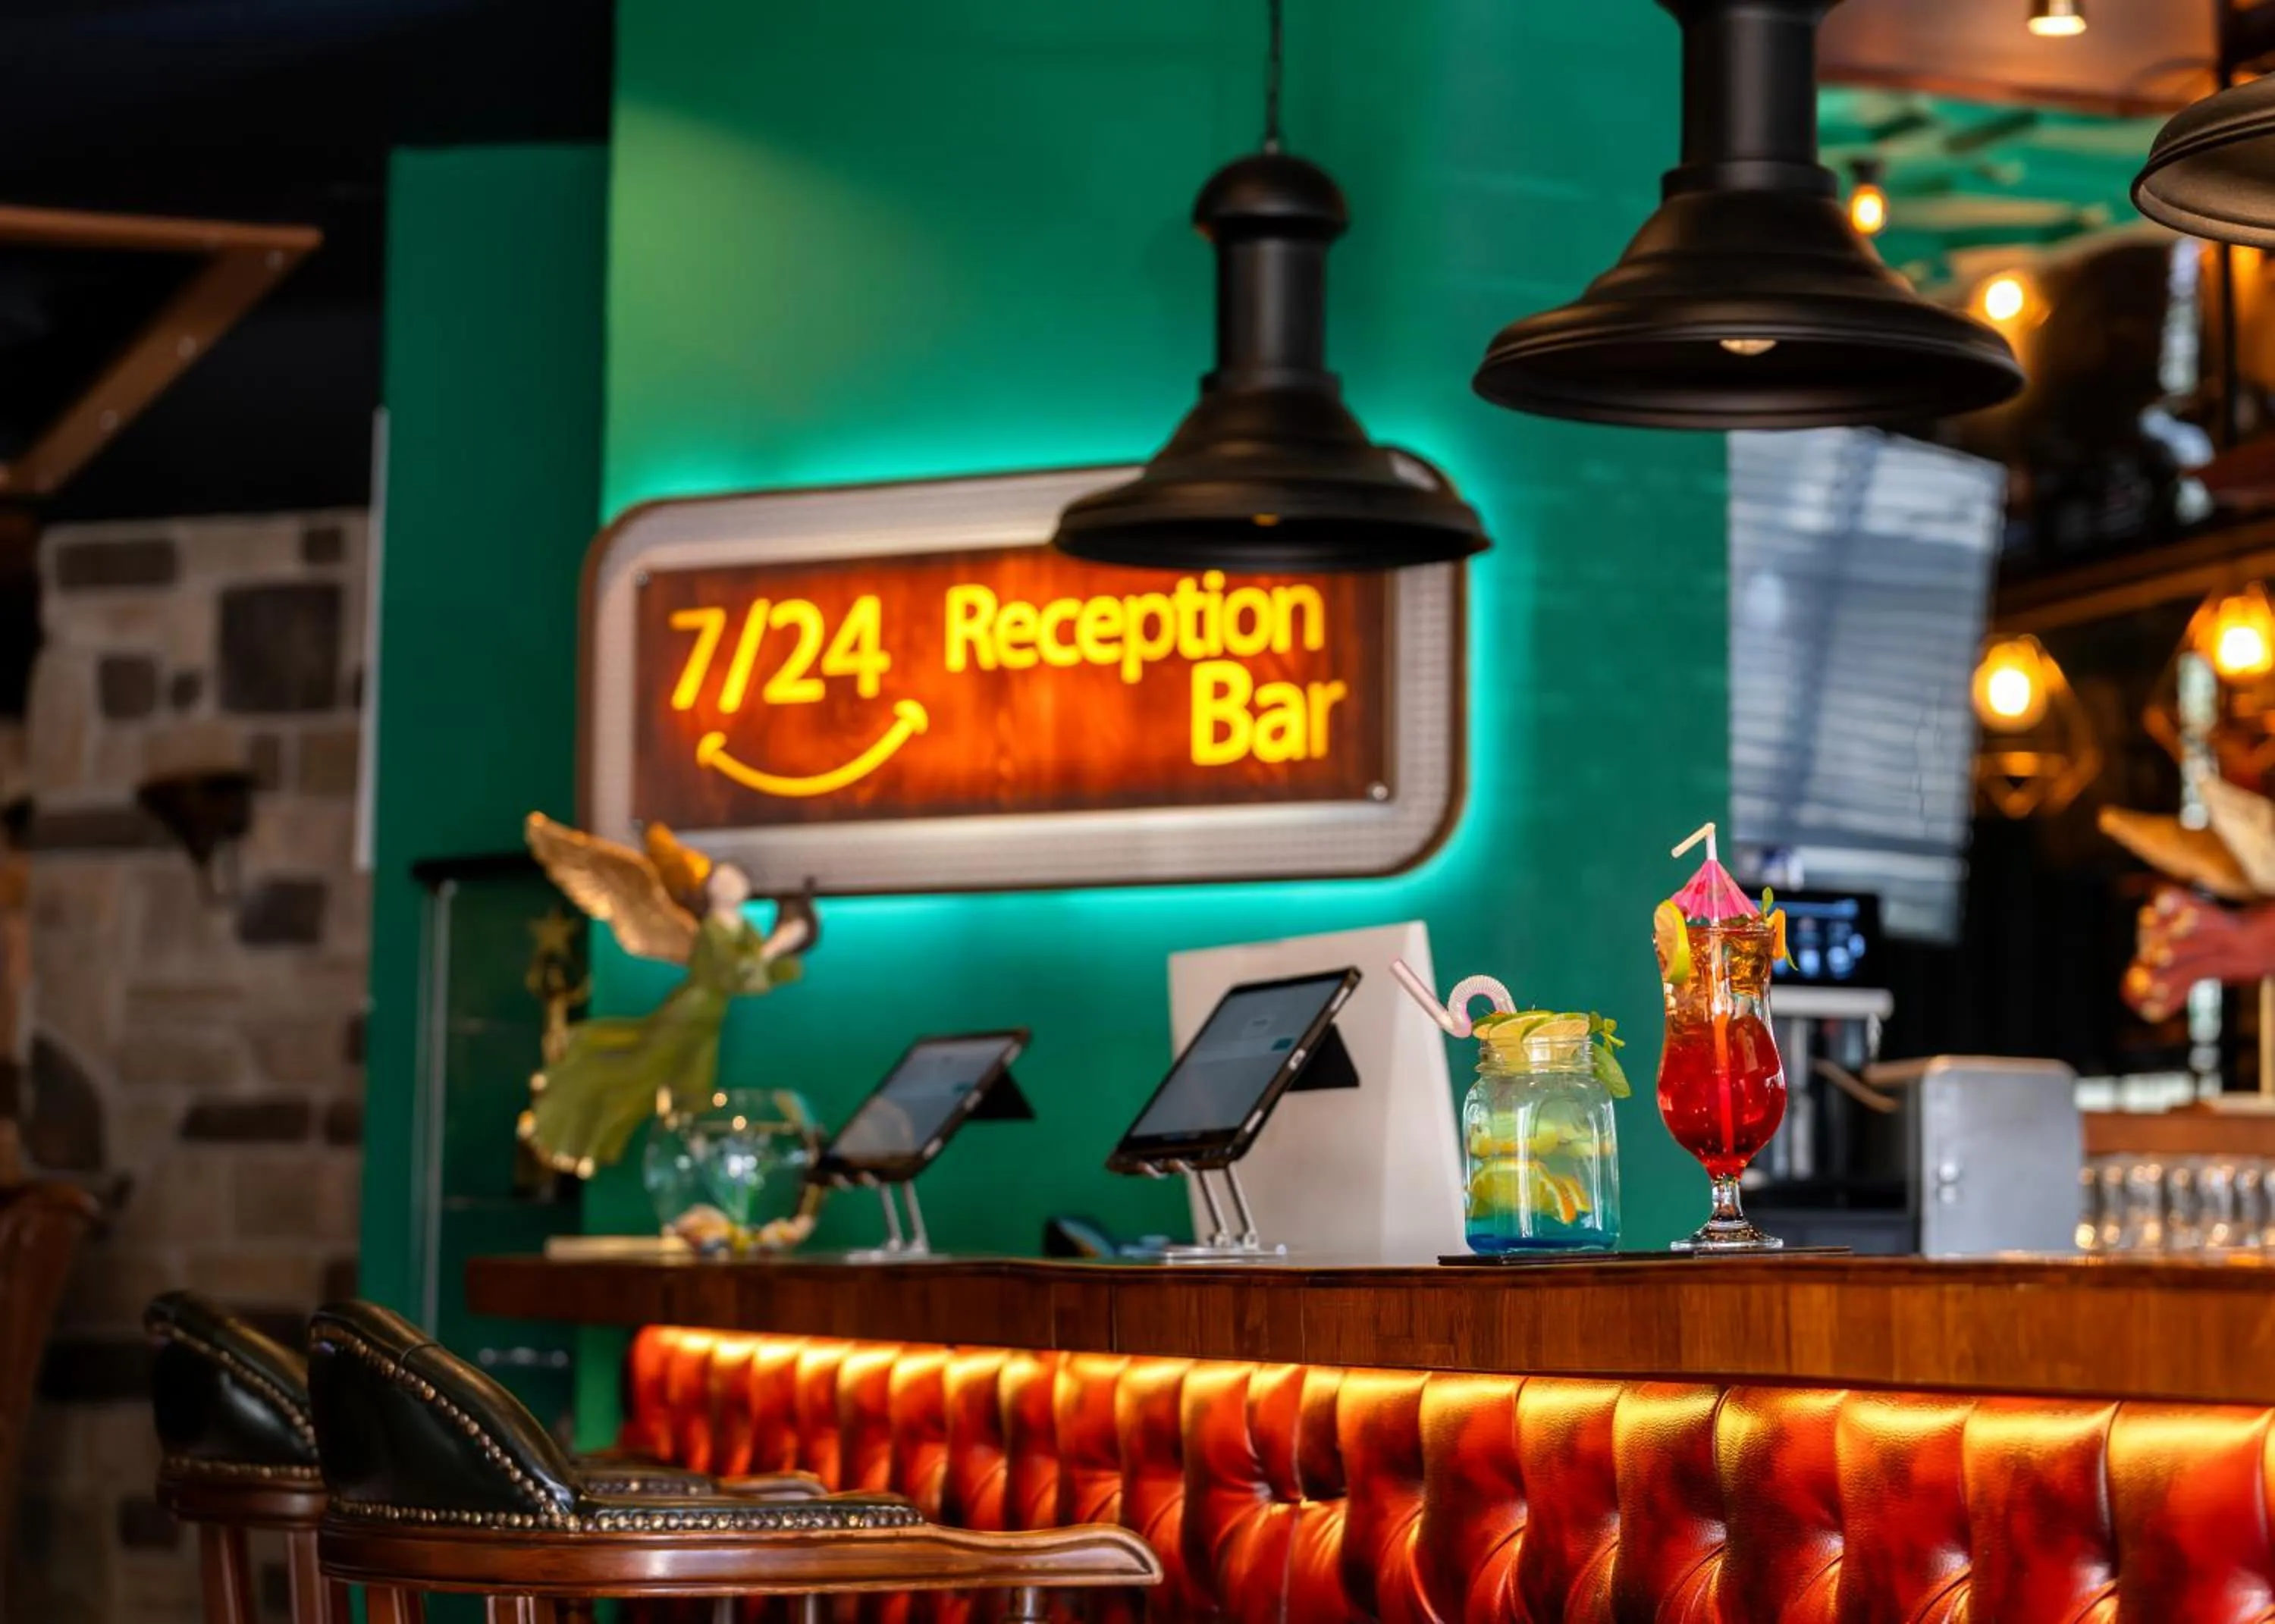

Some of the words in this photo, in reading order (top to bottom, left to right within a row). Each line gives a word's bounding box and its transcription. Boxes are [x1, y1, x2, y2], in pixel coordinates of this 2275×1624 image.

[669, 594, 893, 714] 7/24
[944, 570, 1325, 685] Reception
[1190, 660, 1346, 766] Bar
